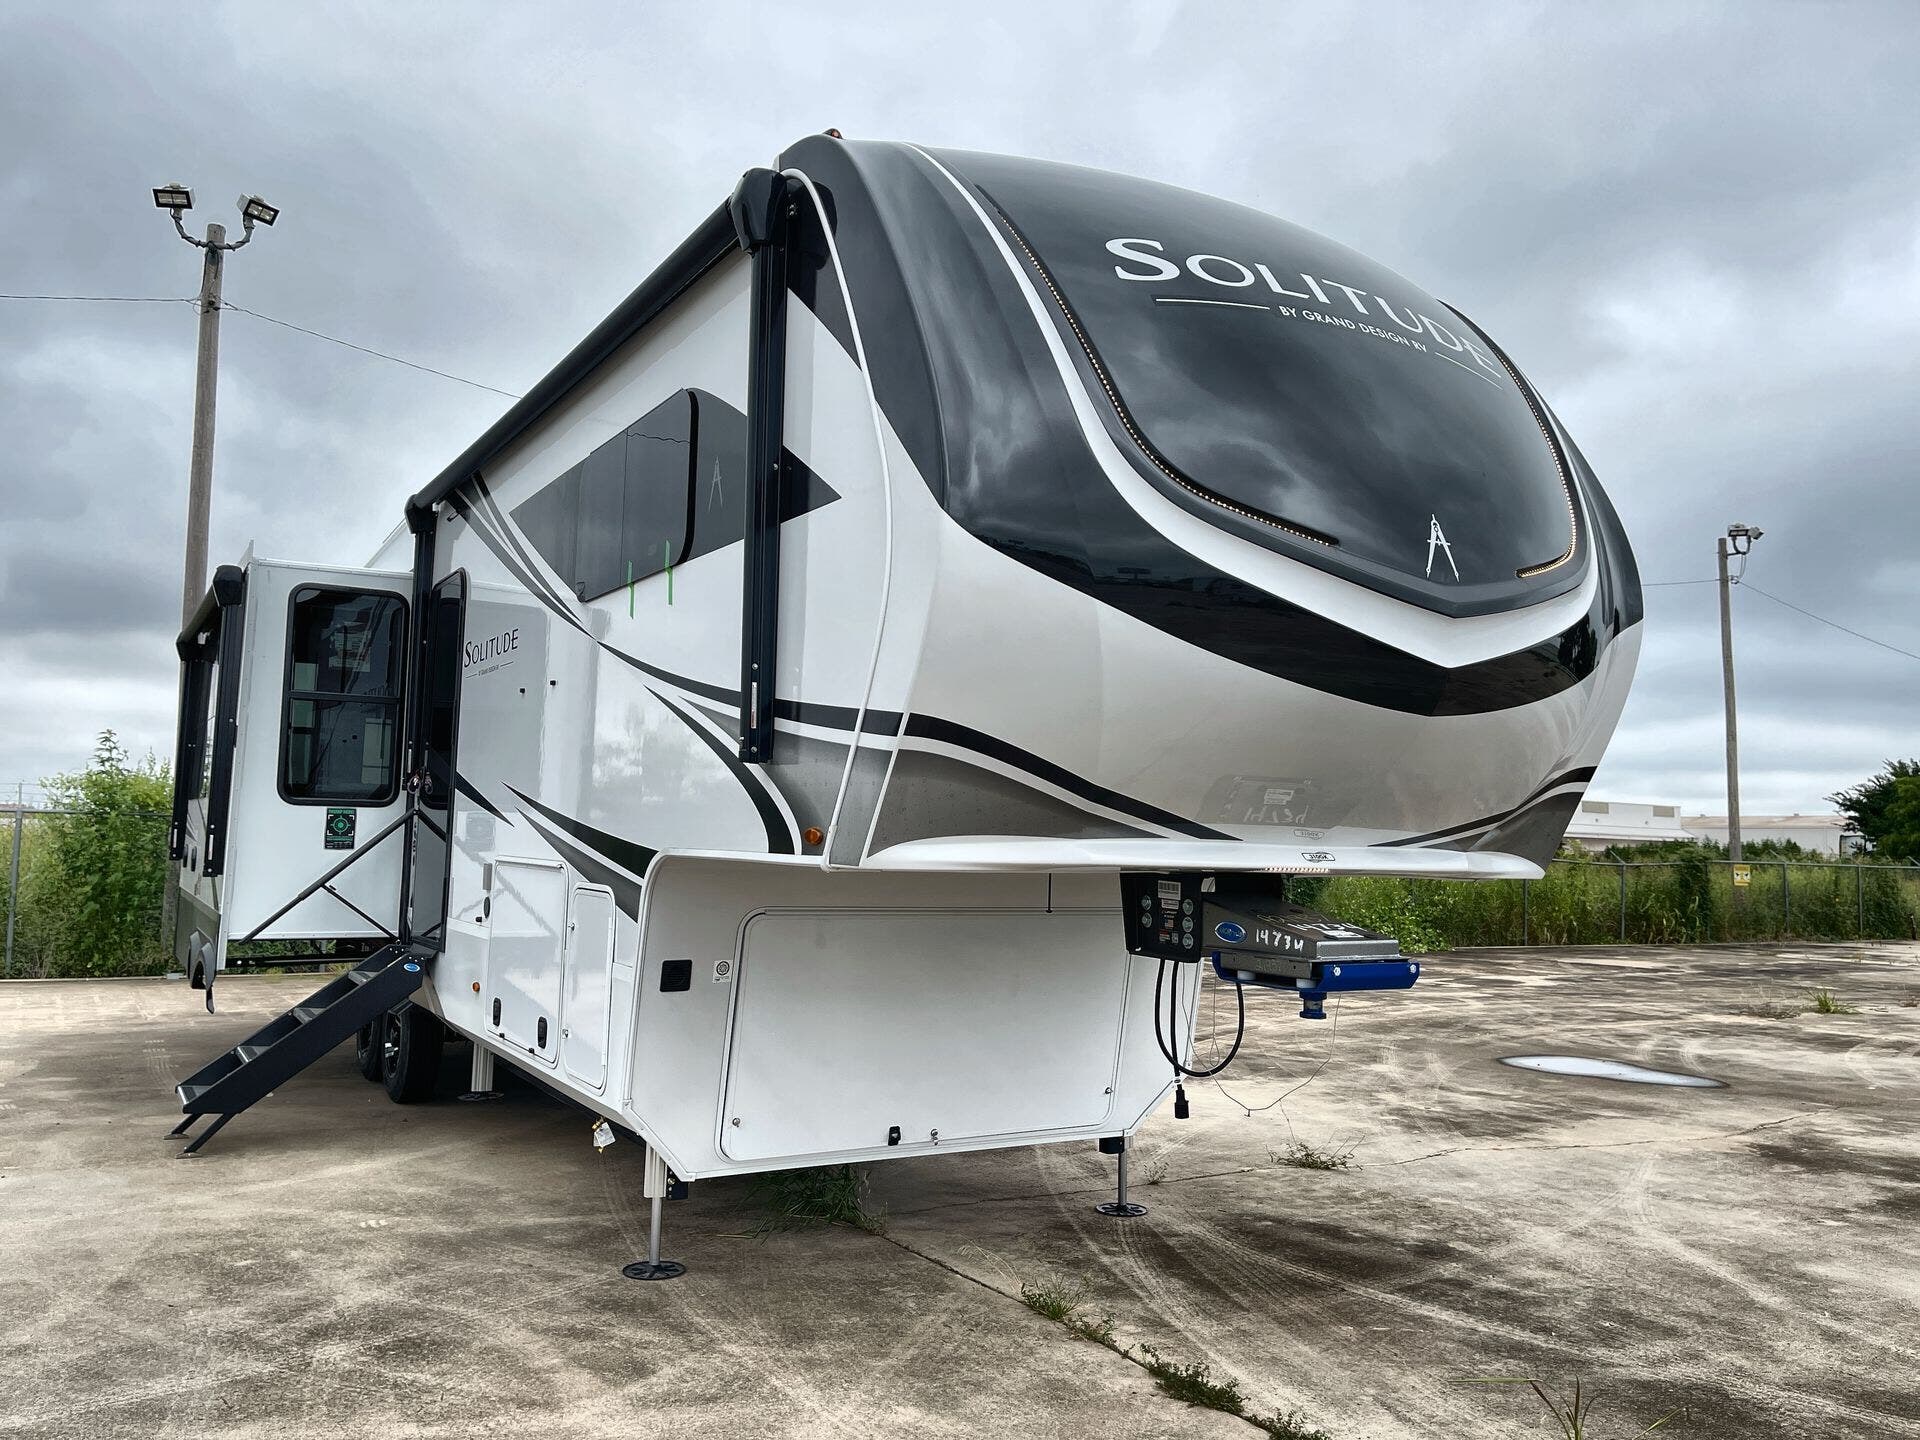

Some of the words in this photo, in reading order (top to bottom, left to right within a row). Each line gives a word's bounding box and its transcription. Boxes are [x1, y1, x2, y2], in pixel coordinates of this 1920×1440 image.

[1105, 237, 1501, 377] SOLITUDE
[1278, 305, 1297, 317] BY
[1302, 309, 1356, 329] GRAND
[1358, 322, 1410, 346] DESIGN
[1411, 339, 1427, 352] RV
[464, 628, 519, 668] SOLITUDE
[1256, 928, 1304, 951] 14734
